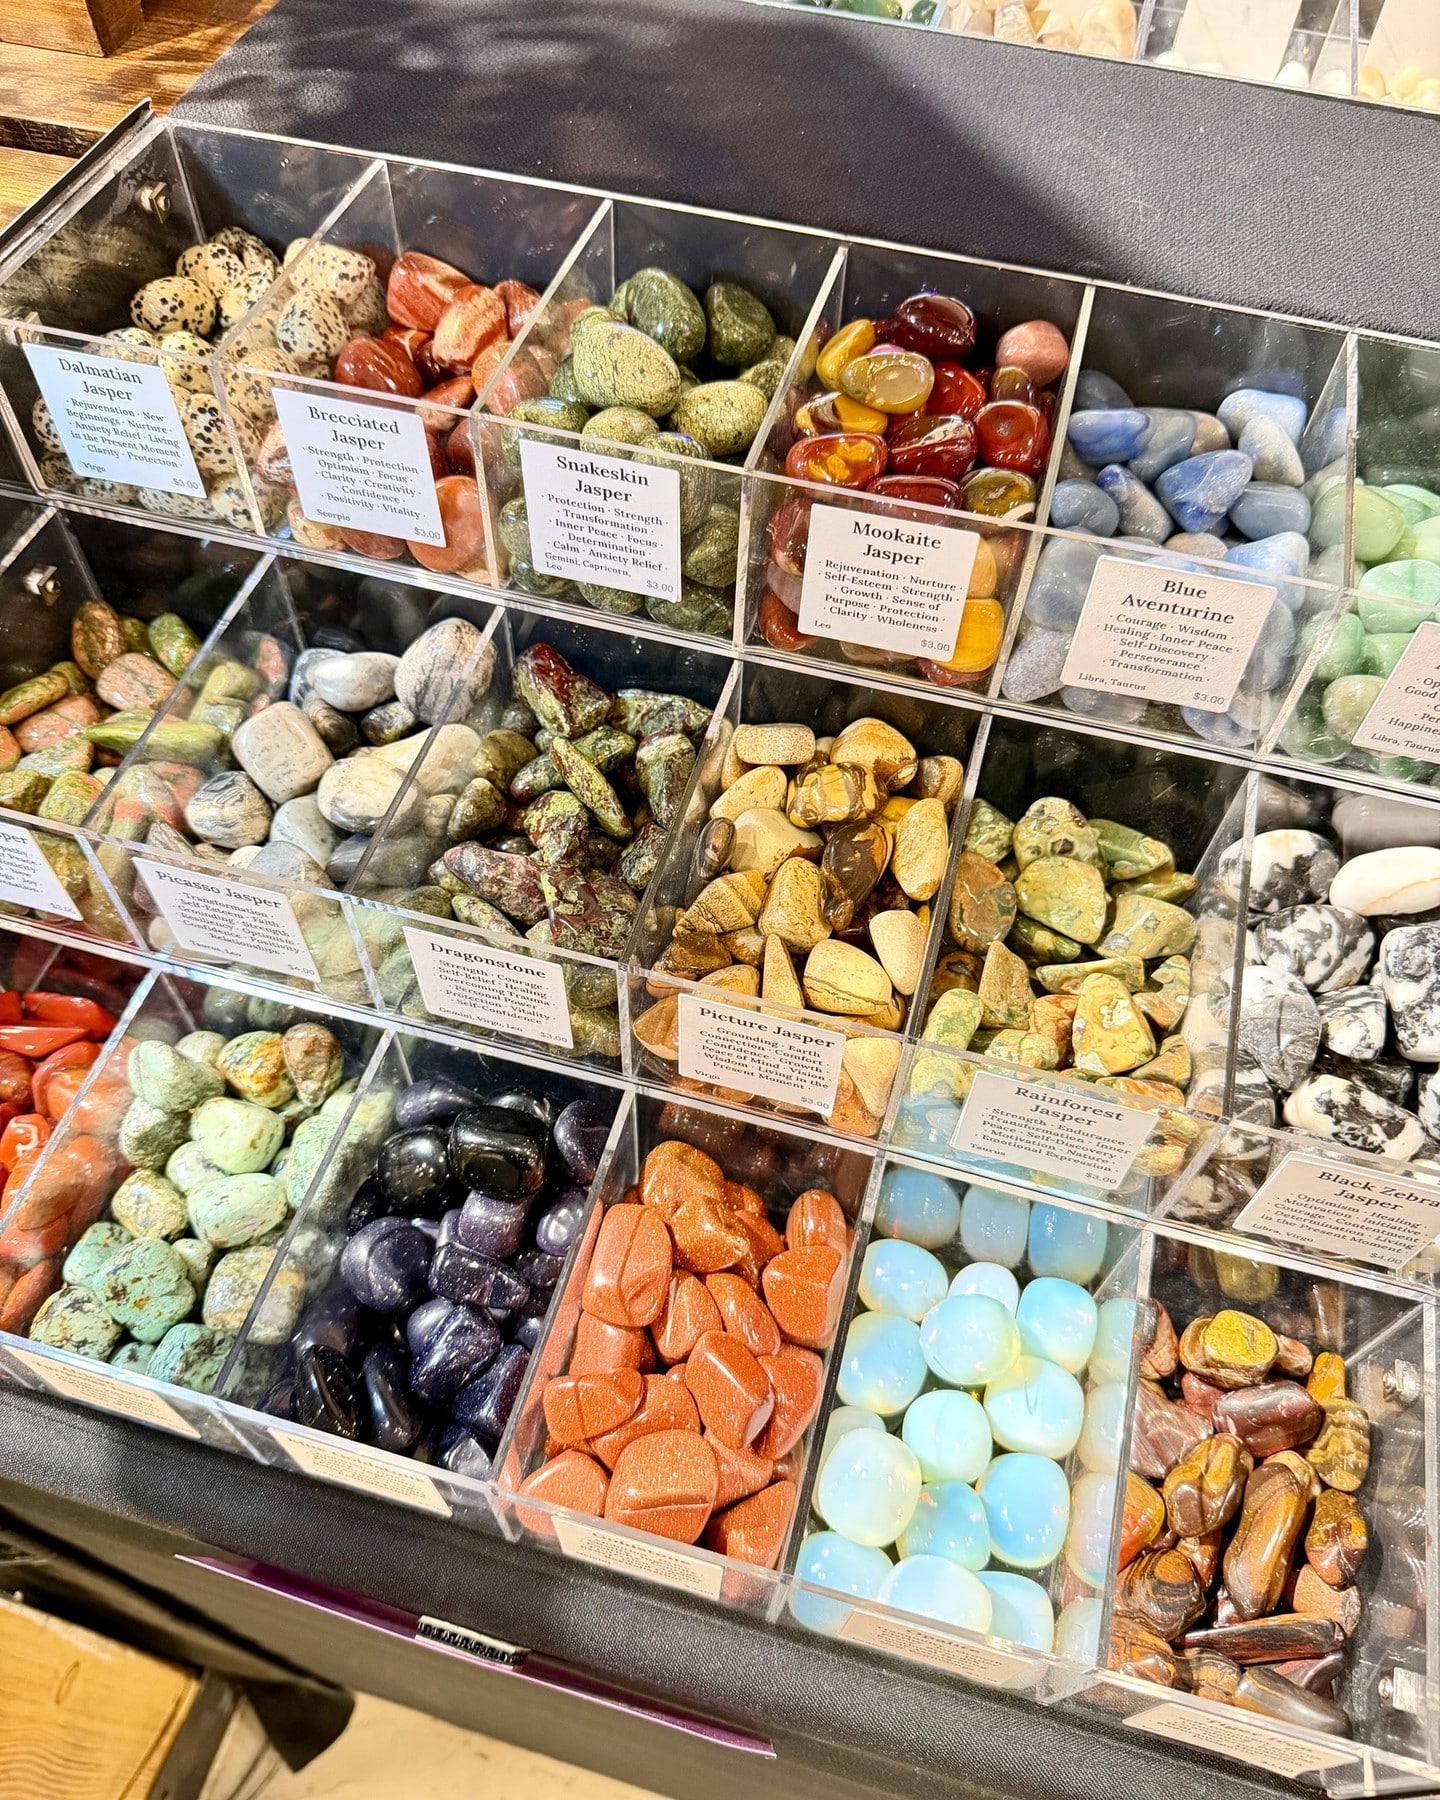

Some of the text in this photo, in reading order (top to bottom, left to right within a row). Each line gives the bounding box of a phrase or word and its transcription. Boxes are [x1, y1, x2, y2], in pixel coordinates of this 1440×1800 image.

[59, 359, 142, 384] Dalmatian
[83, 381, 132, 401] Jasper
[66, 409, 168, 434] Beginnings Nurture
[71, 399, 164, 422] Rejuvenation New
[309, 407, 400, 434] Brecciated
[71, 431, 181, 458] in the Present Moment
[76, 422, 181, 449] Anxiety Relief Living
[333, 430, 385, 451] Jasper
[83, 462, 106, 474] Virgo
[87, 445, 178, 468] Clarity Protection
[308, 446, 418, 474] Strength Protection
[173, 478, 199, 490] $3.00
[319, 460, 408, 483] Optimism Focus
[321, 471, 416, 498] Clarity Creativity
[558, 457, 648, 486] Snakeskin
[342, 486, 400, 504] Confidence
[576, 480, 632, 502] Jasper
[317, 509, 351, 522] Scorpio
[327, 493, 421, 521] Positivity Vitality
[549, 494, 663, 526] Protection Strength
[414, 528, 441, 540] $3.00
[556, 519, 658, 548] Inner Peace Focus
[563, 509, 648, 534] Transformation
[569, 533, 646, 557] Determination
[854, 522, 941, 549] Mookaite
[545, 552, 581, 567] Gemini,
[547, 562, 563, 571] Leo
[553, 541, 662, 571] Calm Anxiety Relief
[864, 545, 924, 565] Jasper
[647, 580, 674, 593] $3.00
[825, 572, 953, 602] Self-Esteem Strength
[826, 560, 957, 592] Rejuvenation Nurture
[841, 587, 882, 601] Growth
[893, 596, 926, 609] Sense
[1163, 581, 1207, 599] Blue
[826, 595, 939, 622] Purpose Protection
[830, 607, 938, 633] Clarity Wholeness
[1122, 595, 1234, 624] Aventurine
[815, 621, 832, 629] Leo
[1117, 614, 1227, 640] Courage Wisdom
[921, 640, 950, 652] $3.00
[1104, 624, 1233, 654] Healing Inner Peace
[1120, 639, 1209, 663] Self-Discovery
[1110, 659, 1203, 682] Transformation
[1120, 650, 1200, 671] Perseverance
[1079, 673, 1146, 691] Libra, Taurus
[1405, 686, 1438, 699] Good
[1193, 693, 1225, 705] $3.00
[1371, 733, 1400, 746] Libra,
[156, 871, 281, 909] Picasso Jasper
[183, 893, 268, 918] Transformation
[178, 906, 290, 938] Grounding Strength
[431, 944, 545, 978] Dragonstone
[439, 967, 547, 1000] Self-Belief Healing
[440, 960, 543, 990] Strength Courage
[440, 975, 550, 1006] Overcoming Trauma
[456, 985, 537, 1010] Personal Power
[447, 990, 550, 1021] Protection Vitality
[457, 1000, 542, 1024] Self-Confidence
[541, 1032, 568, 1043] $3.00
[701, 1008, 835, 1048] Picture Jasper
[700, 1031, 822, 1066] Connection Comfort
[717, 1028, 820, 1058] Grounding Earth
[703, 1045, 733, 1057] Peace
[751, 1058, 780, 1069] Mind
[790, 1068, 825, 1081] Vision
[704, 1053, 748, 1068] Wisdom
[759, 1067, 793, 1081] Living
[796, 1076, 807, 1084] in
[706, 1040, 823, 1073] Confidence Growth
[695, 1070, 721, 1080] Virgo
[714, 1062, 804, 1090] Present Moment
[801, 1097, 830, 1110] $3.00
[1016, 1088, 1123, 1121] Rainforest
[1031, 1105, 1097, 1126] Jasper
[983, 1121, 1117, 1159] Peace Self-Discovery
[989, 1115, 1131, 1155] Transformation Inner
[993, 1109, 1125, 1146] Strength Endurance
[971, 1143, 1006, 1156] Taurus
[983, 1135, 1112, 1172] Emotional Expression
[991, 1130, 1109, 1164] Motivation Nature
[1085, 1173, 1117, 1185] $3.00
[1318, 1172, 1440, 1208] Black Zebra
[1298, 1194, 1422, 1229] Optimism Healing
[1335, 1190, 1403, 1210] Jasper
[1275, 1204, 1419, 1243] Courage Contentment
[1284, 1199, 1421, 1235] Motivation Initiative
[1253, 1224, 1314, 1243] Libra, Virgo
[1275, 1211, 1416, 1251] Determination Living
[1277, 1219, 1297, 1227] the
[1300, 1224, 1347, 1240] Present
[1350, 1237, 1402, 1254] Moment
